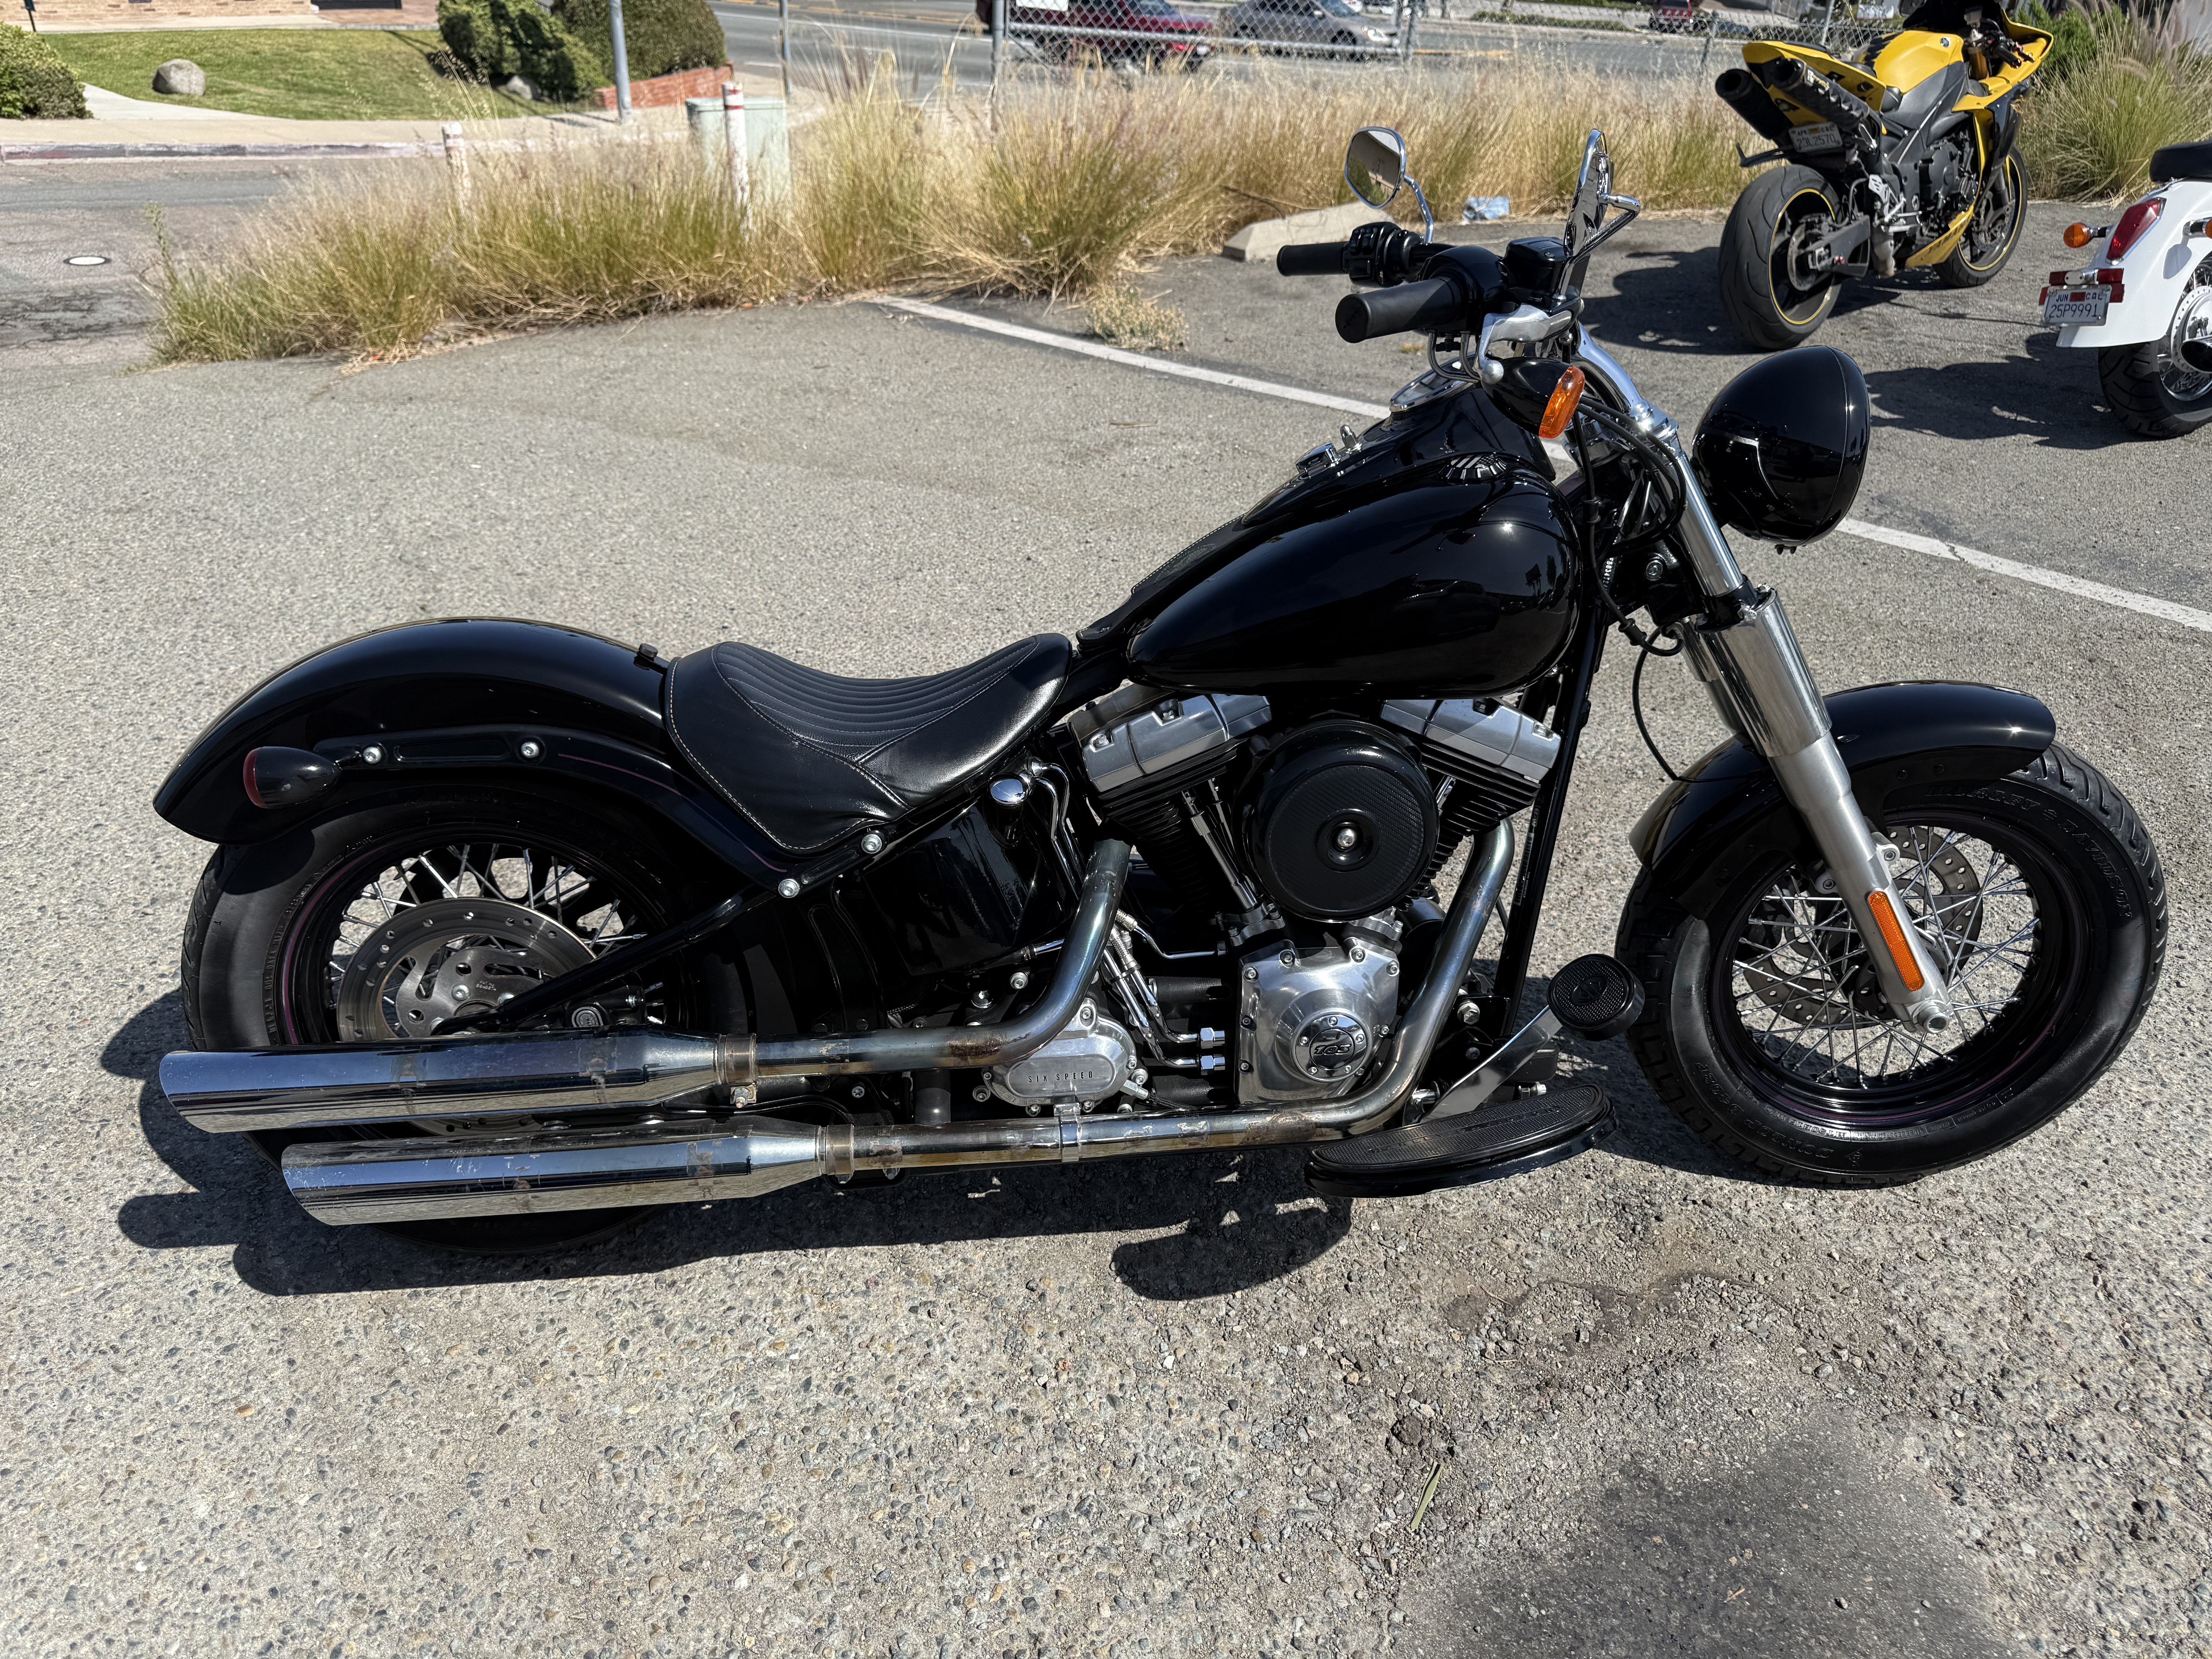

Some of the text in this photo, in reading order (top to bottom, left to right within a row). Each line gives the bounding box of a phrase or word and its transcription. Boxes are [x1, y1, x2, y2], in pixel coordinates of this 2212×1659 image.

[2056, 292, 2103, 302] JUN CAL
[2049, 303, 2097, 318] 25P9991
[2058, 819, 2133, 918] DAVIDSON
[1314, 1044, 1352, 1056] 103
[1028, 1071, 1092, 1083] SIX SPEED
[1695, 1062, 1834, 1158] DUNLOP D402F
[1891, 1128, 1922, 1138] TUBELESS
